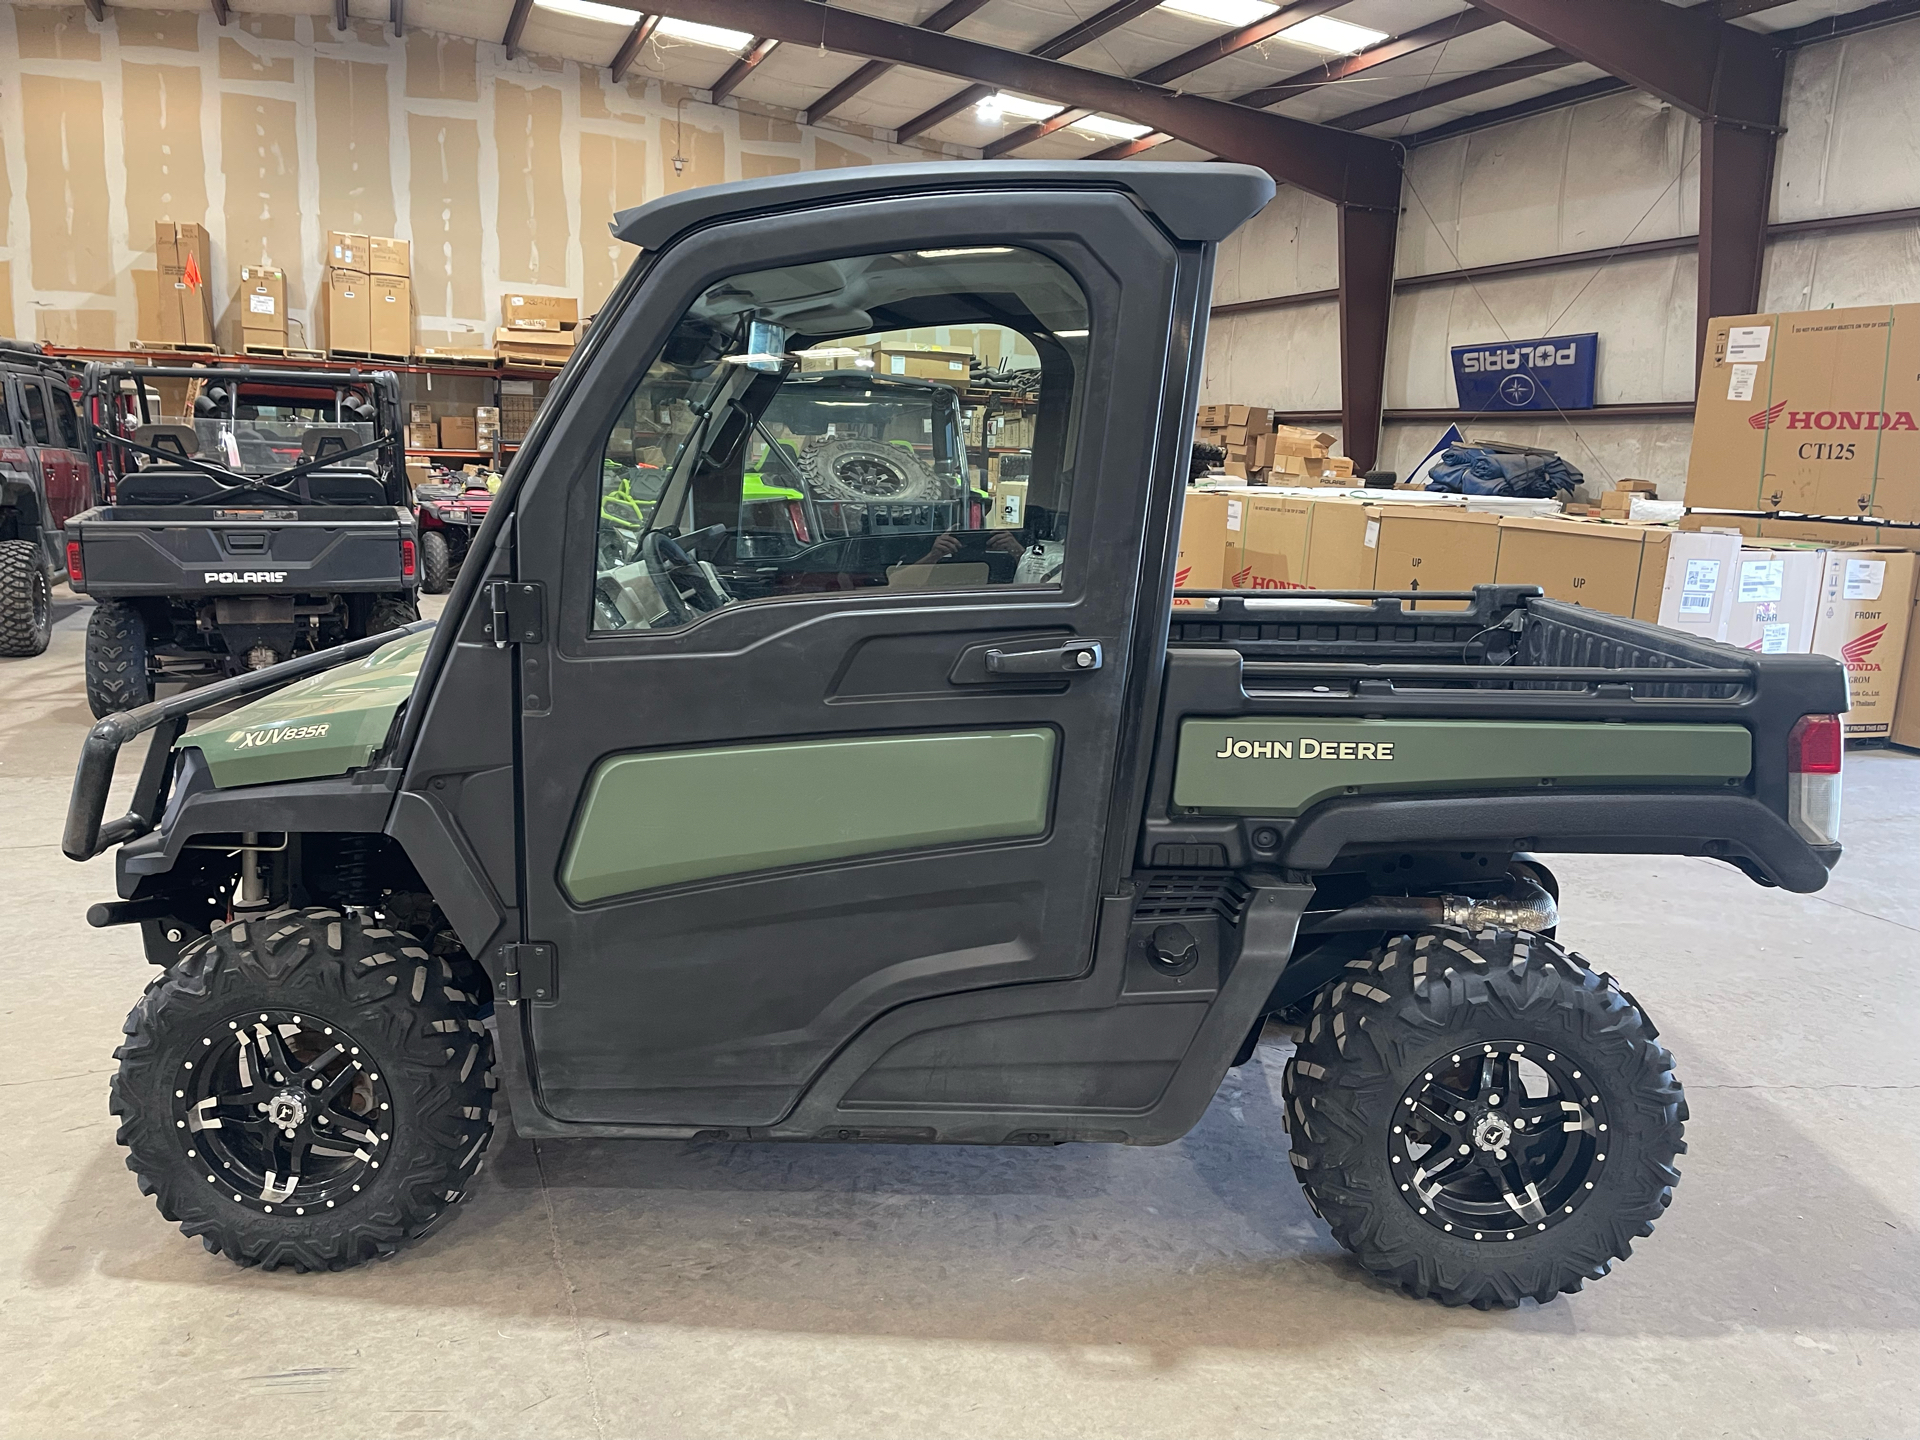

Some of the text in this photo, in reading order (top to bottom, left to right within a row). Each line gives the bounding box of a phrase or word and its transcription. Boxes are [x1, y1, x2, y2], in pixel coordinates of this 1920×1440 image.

[1462, 343, 1577, 373] POLARIS
[1786, 411, 1919, 431] HONDA
[1798, 443, 1856, 460] CT125
[1411, 557, 1422, 567] UP
[204, 572, 288, 584] POLARIS
[1573, 577, 1586, 588] UP
[1854, 611, 1882, 620] FRONT
[1849, 676, 1870, 684] GROM
[235, 723, 331, 750] XUV835R
[1216, 737, 1395, 760] JOHN DEERE
